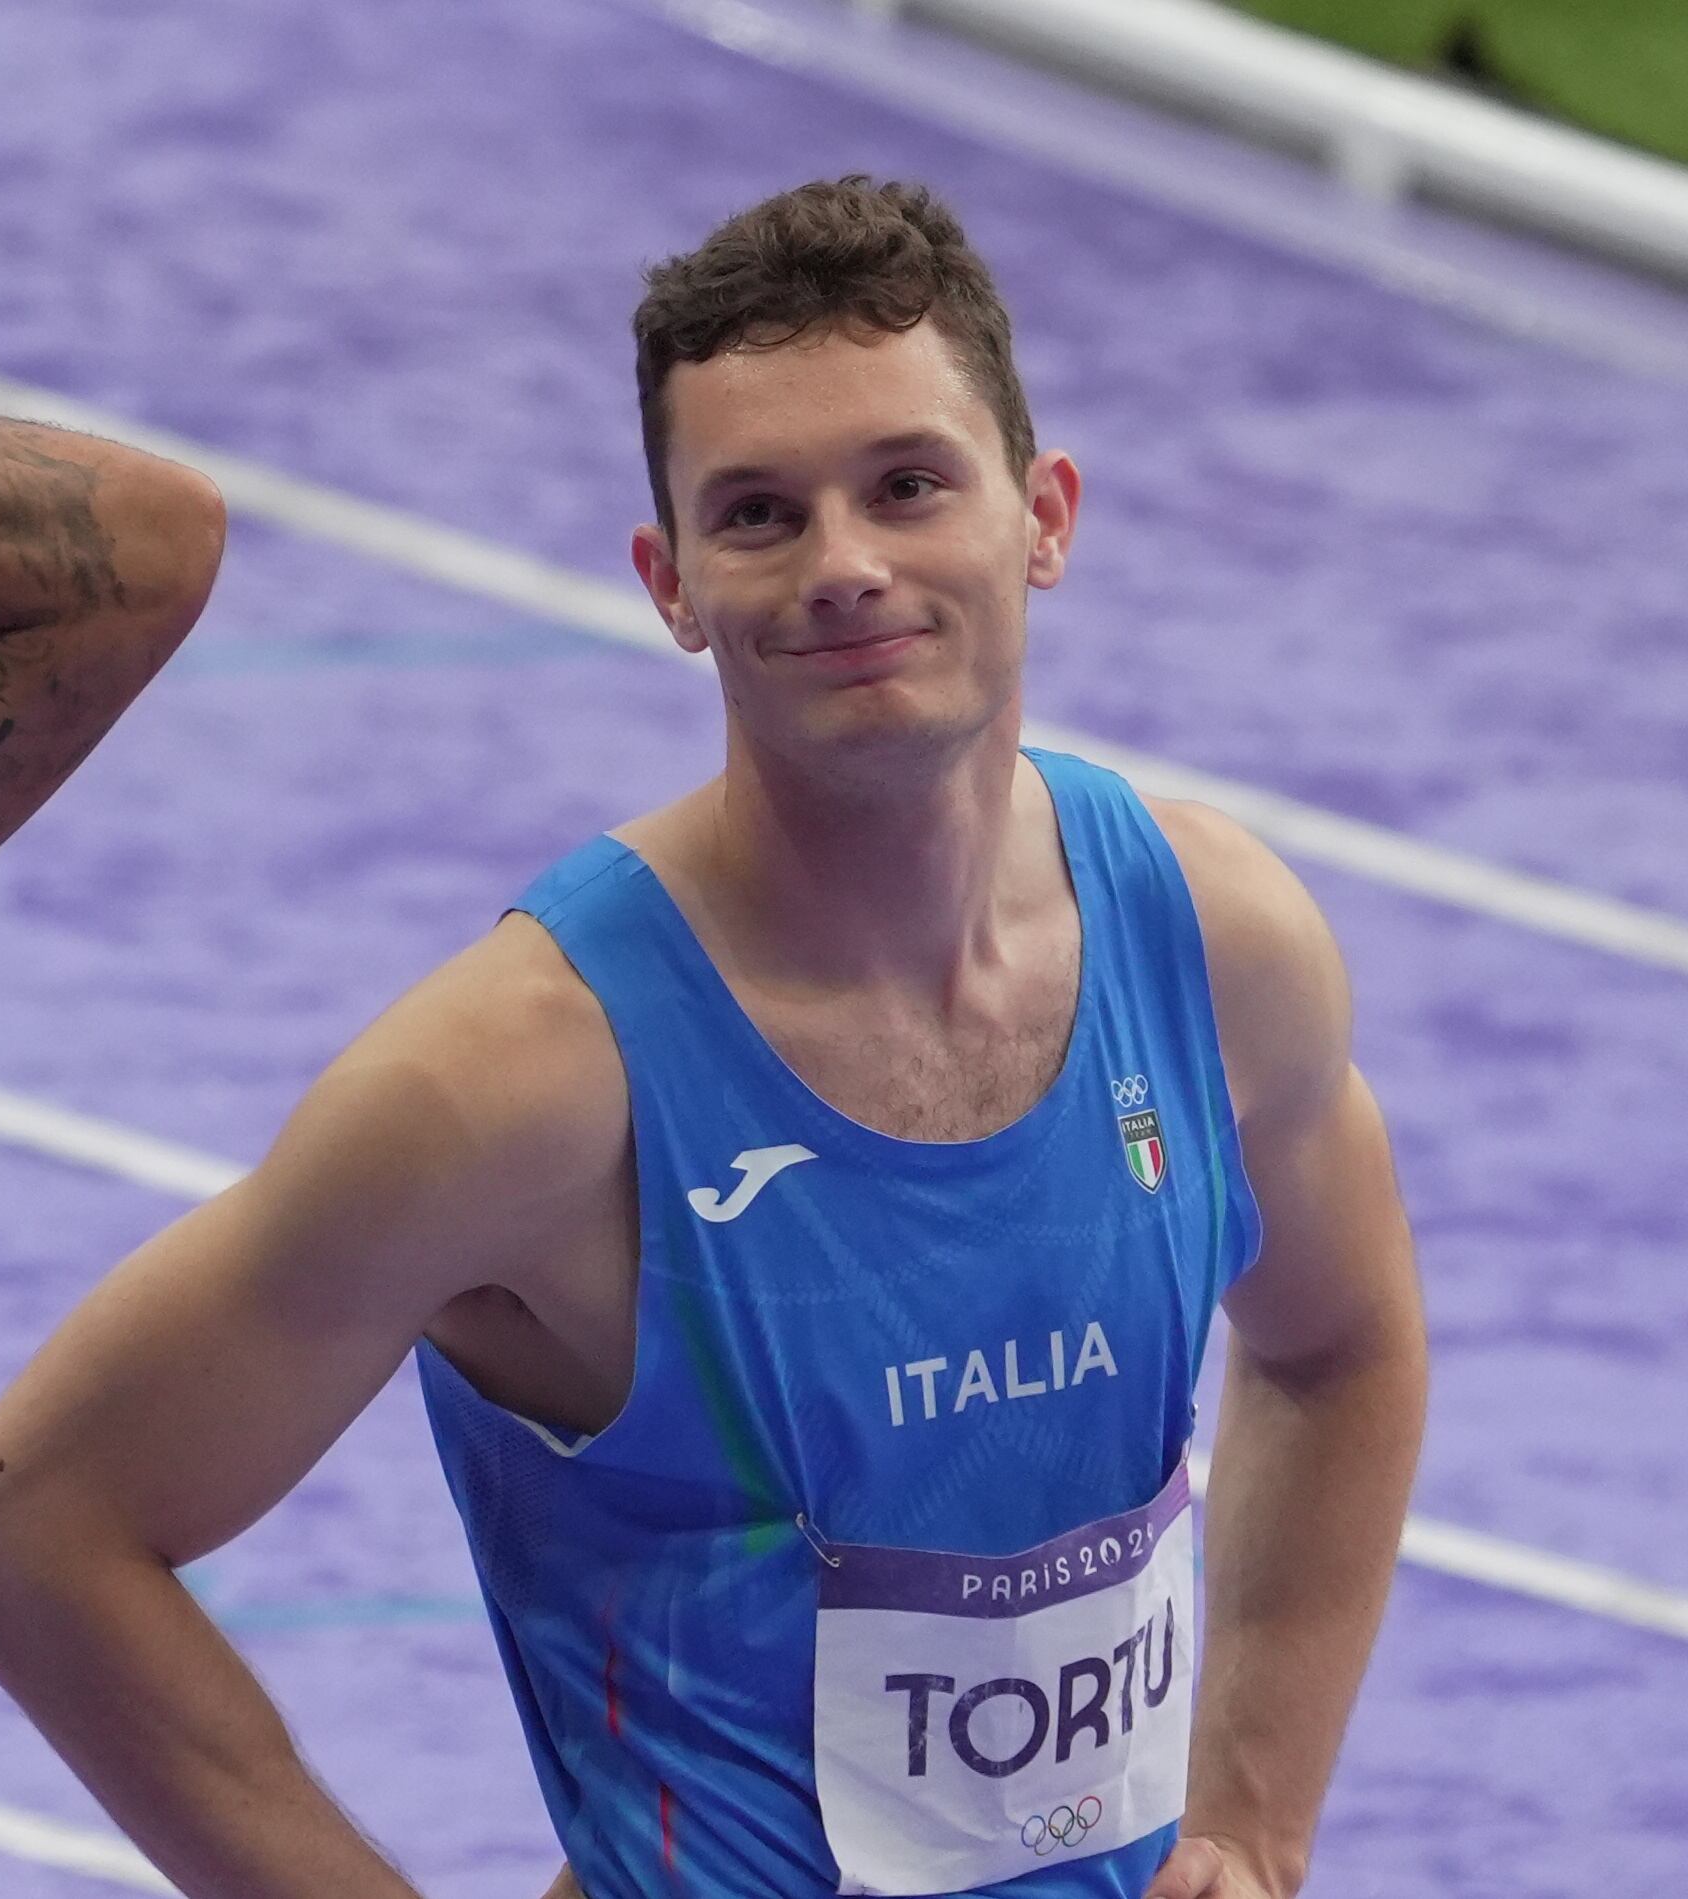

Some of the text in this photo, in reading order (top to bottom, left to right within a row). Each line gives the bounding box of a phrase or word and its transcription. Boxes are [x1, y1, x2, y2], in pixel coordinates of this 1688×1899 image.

[1121, 1116, 1156, 1133] ITALIA
[885, 1321, 1119, 1427] ITALIA
[884, 1595, 1174, 1779] TORTU
